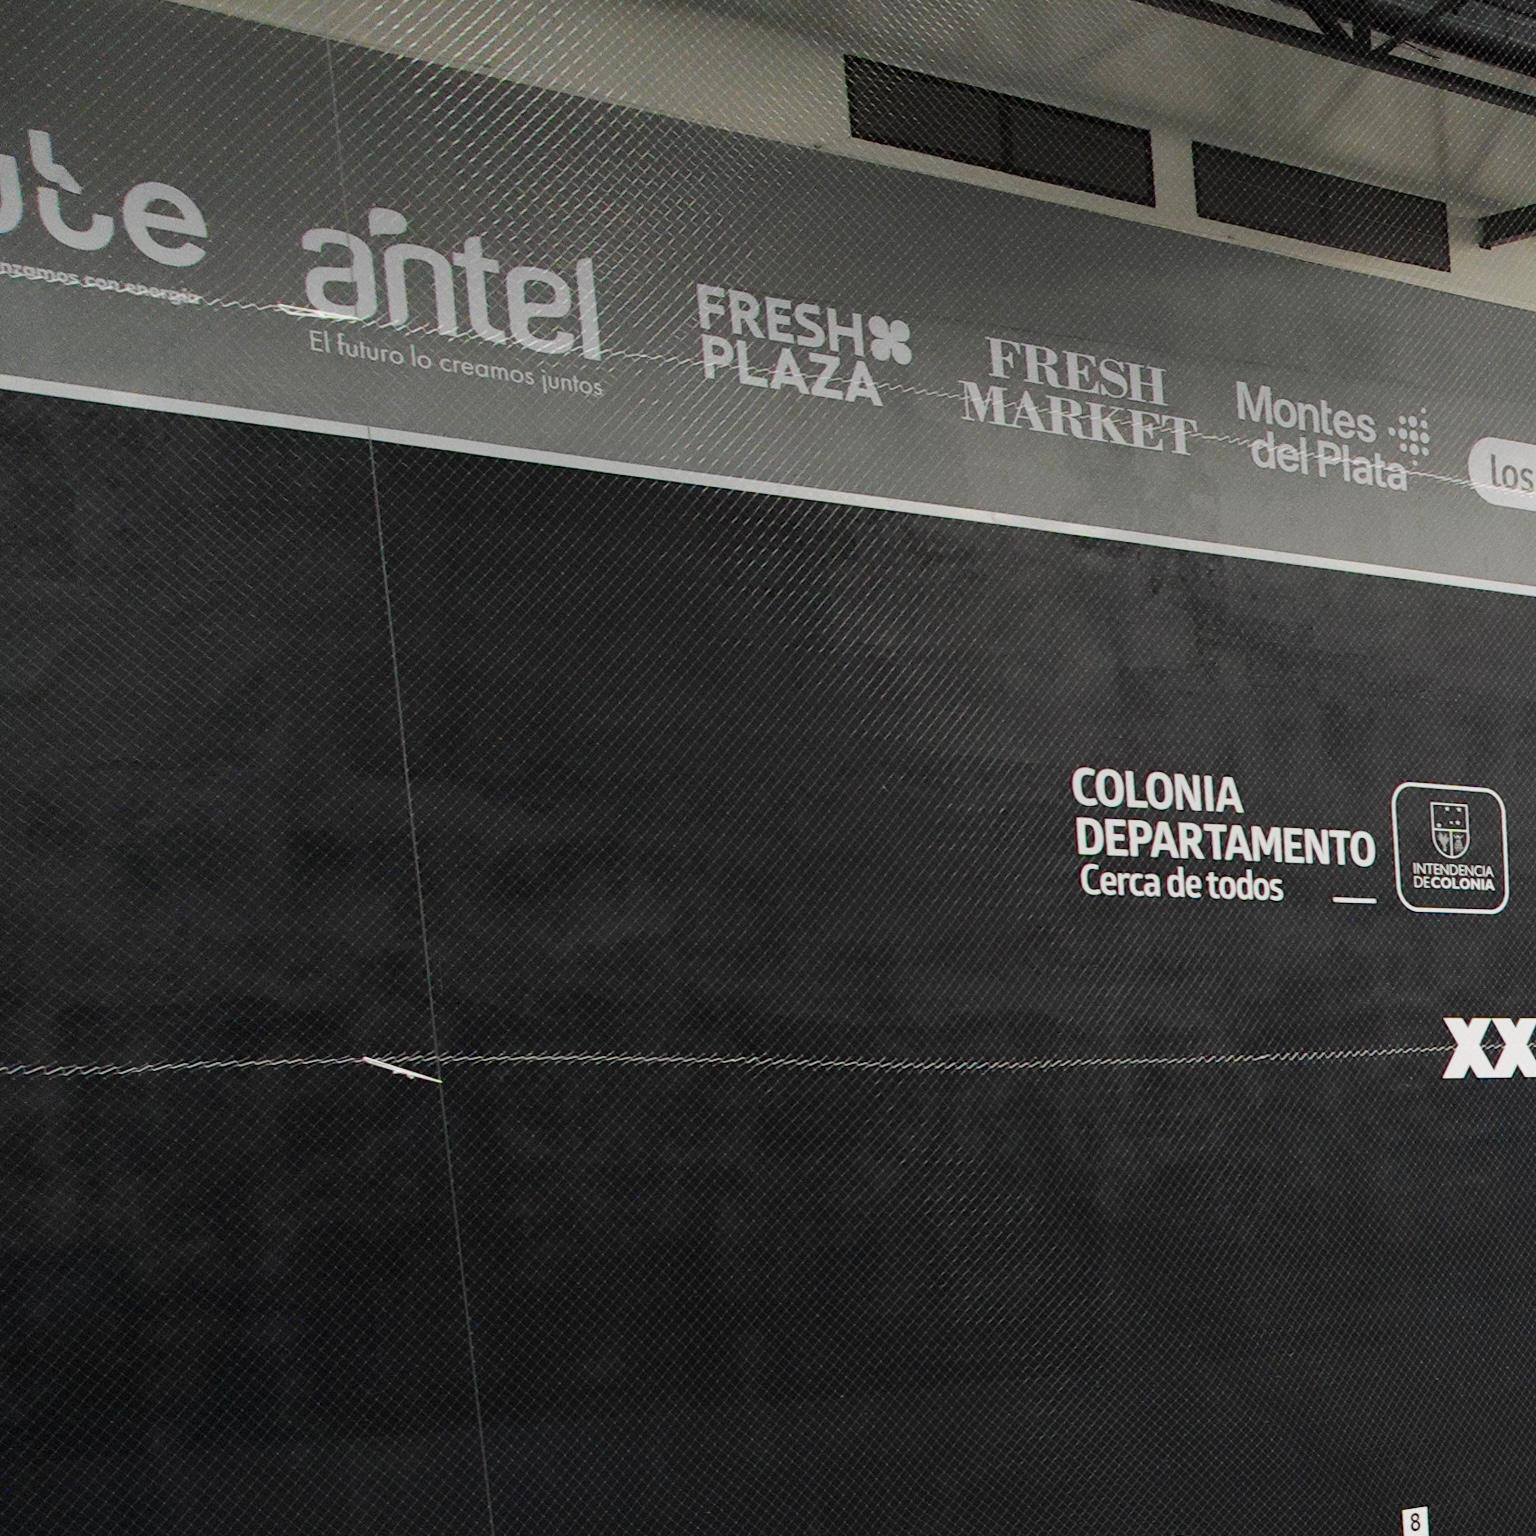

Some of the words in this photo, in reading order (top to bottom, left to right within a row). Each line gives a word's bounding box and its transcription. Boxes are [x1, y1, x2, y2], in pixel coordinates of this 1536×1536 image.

[697, 284, 866, 358] FRESH
[308, 330, 332, 354] El
[336, 332, 404, 366] futuro
[410, 345, 432, 369] lo
[439, 356, 535, 386] creamos
[541, 369, 604, 397] juntos
[700, 333, 883, 408] PLAZA
[984, 336, 1168, 407] FRESH
[957, 379, 1198, 456] MARKET
[1235, 380, 1378, 444] Montes
[1250, 430, 1310, 477] del
[1317, 438, 1409, 493] Plata
[1489, 453, 1535, 492] los
[1071, 766, 1245, 814] COLONIA
[1074, 815, 1377, 868] DEPARTAMENTO
[1411, 861, 1494, 878] INTENDENCIA
[1079, 863, 1162, 898] Cerca
[1166, 866, 1203, 899] de
[1206, 869, 1285, 902] todos
[1410, 1512, 1422, 1532] 8
